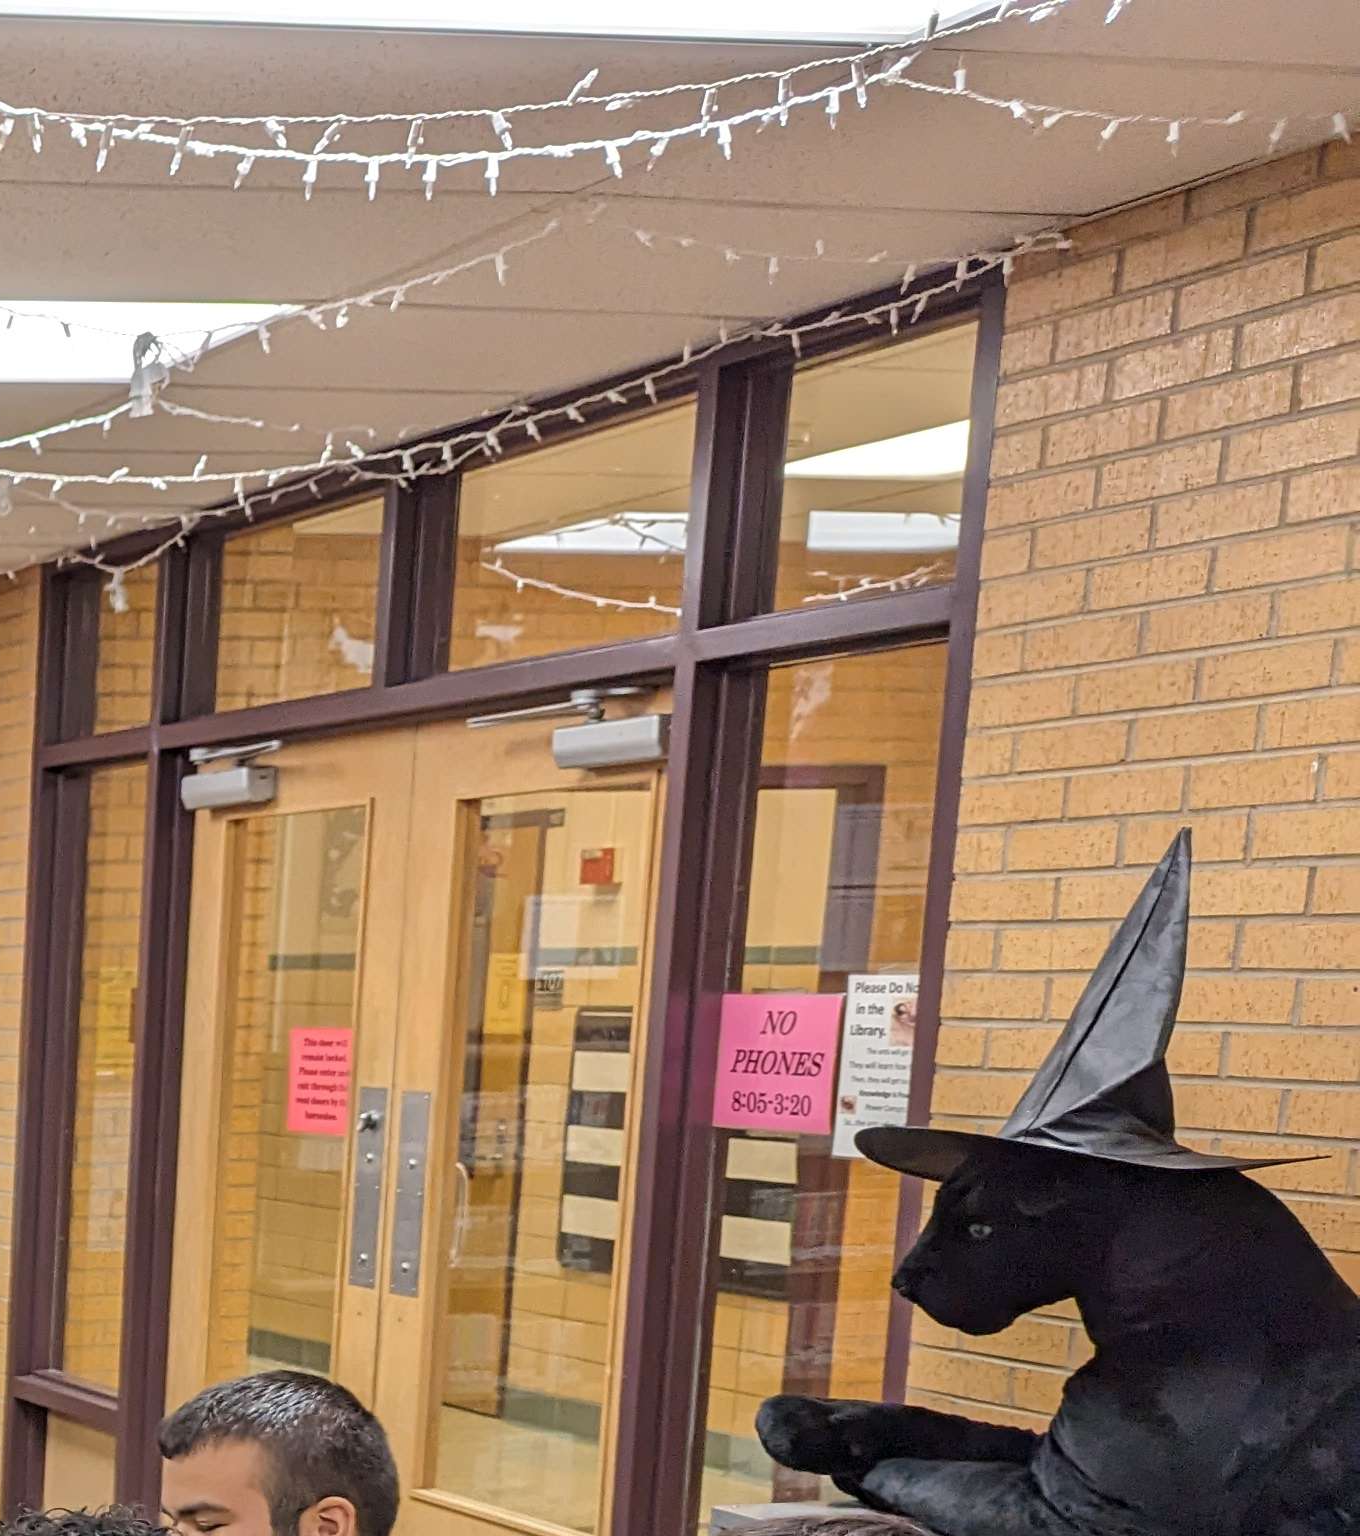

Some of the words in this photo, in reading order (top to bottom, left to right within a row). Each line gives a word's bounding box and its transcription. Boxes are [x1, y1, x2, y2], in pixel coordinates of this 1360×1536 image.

[855, 982, 886, 993] Please
[889, 982, 903, 993] Do
[906, 982, 920, 993] No
[855, 1003, 866, 1014] in
[868, 1003, 885, 1015] the
[760, 1011, 798, 1035] NO
[849, 1024, 886, 1039] Library.
[730, 1049, 825, 1077] PHONES
[731, 1091, 812, 1117] 8:05-3:20
